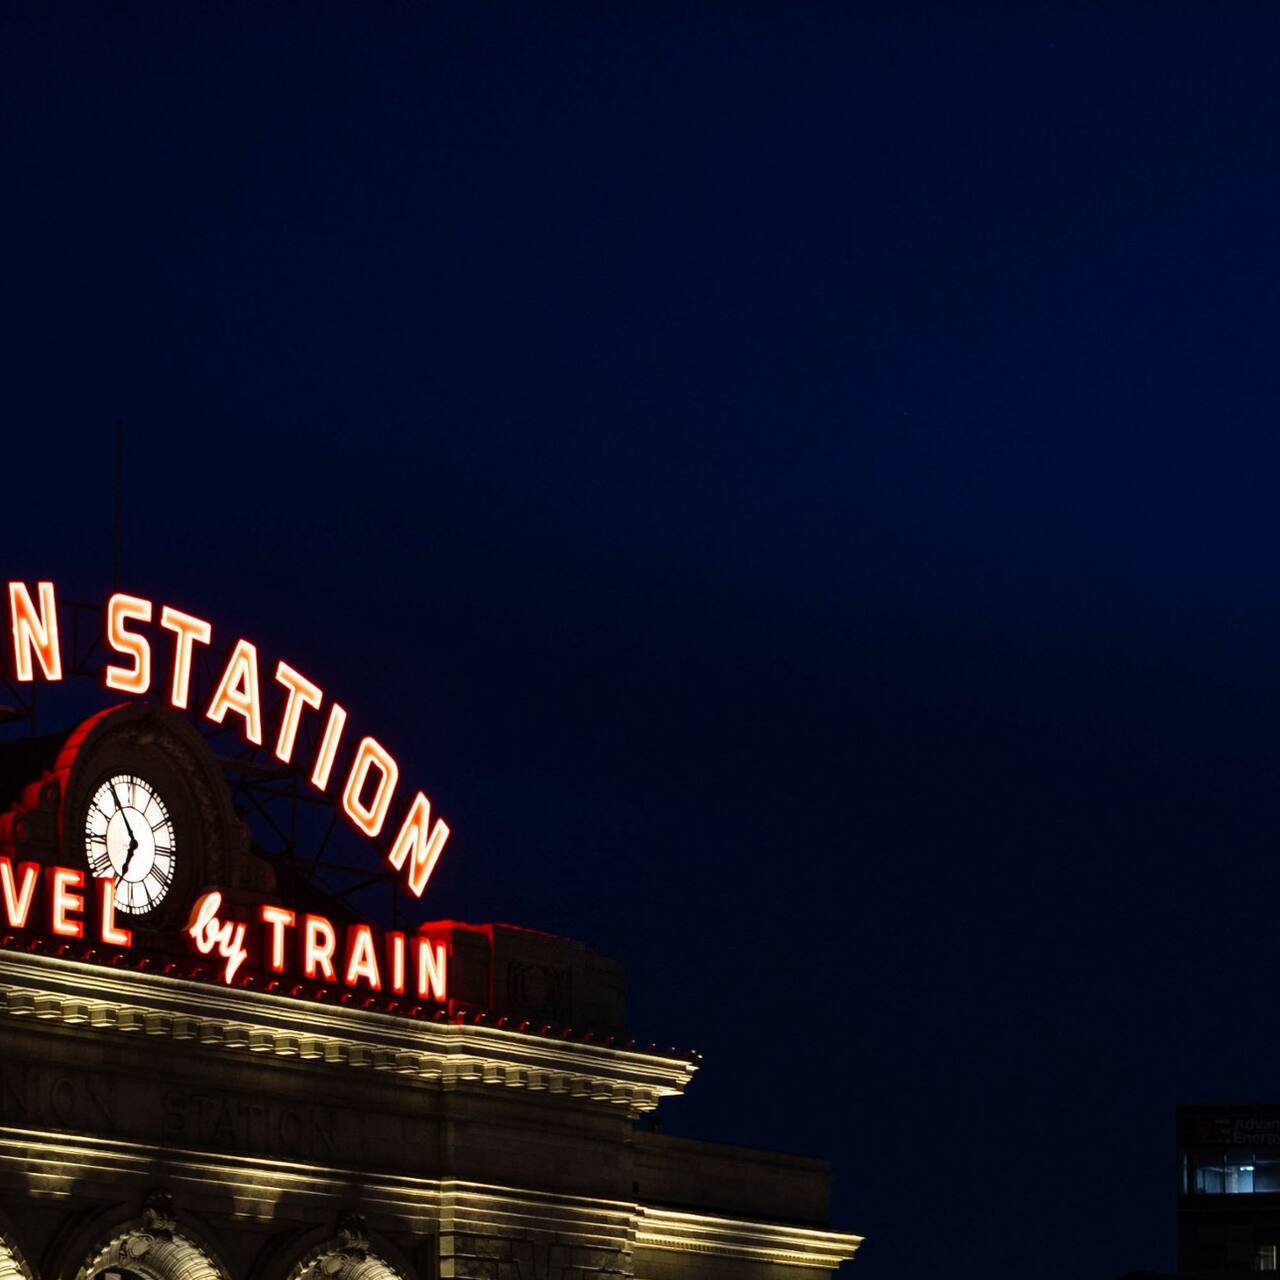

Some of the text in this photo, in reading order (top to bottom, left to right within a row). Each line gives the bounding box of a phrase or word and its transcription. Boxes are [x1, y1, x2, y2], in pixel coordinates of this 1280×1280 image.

[106, 593, 449, 898] STATION
[189, 891, 247, 984] by
[263, 906, 447, 1001] TRAIN
[162, 1092, 337, 1152] STATION
